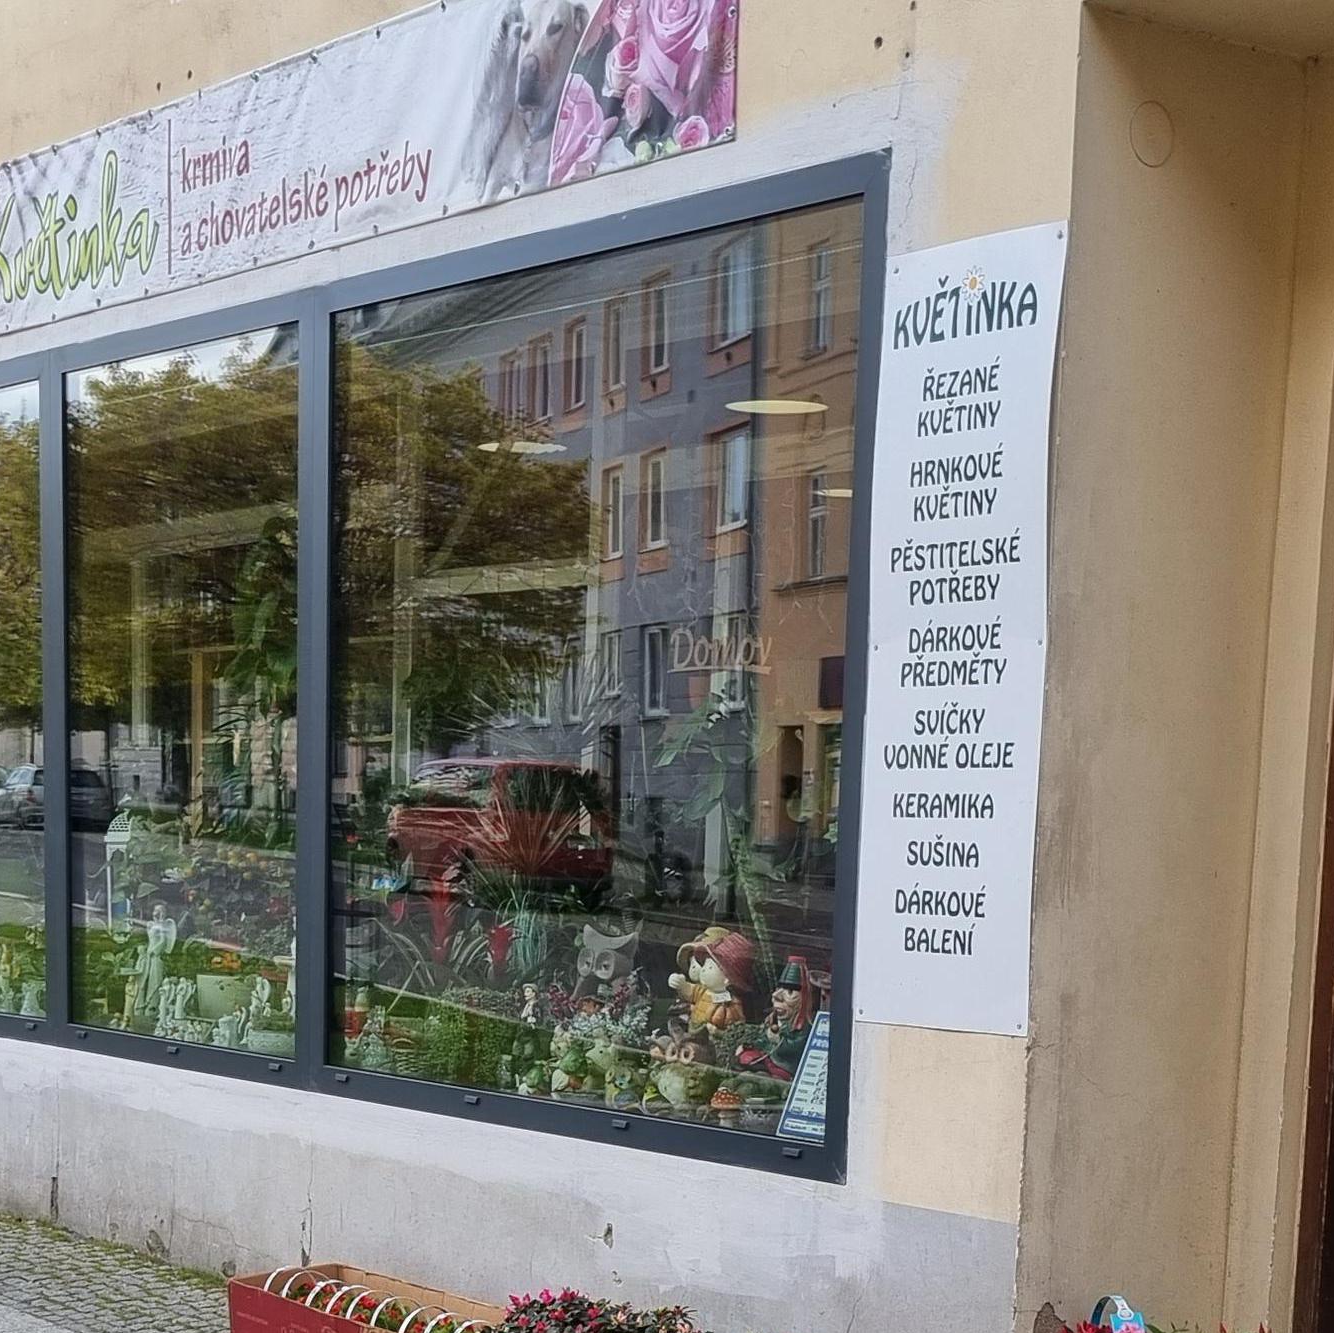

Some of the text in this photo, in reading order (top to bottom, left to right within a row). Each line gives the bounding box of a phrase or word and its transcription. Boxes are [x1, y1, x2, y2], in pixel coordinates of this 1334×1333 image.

[181, 136, 250, 193] krmiva
[181, 140, 433, 256] a chovatelské potřeby
[893, 275, 1038, 350] KVĚTINKA
[922, 355, 1001, 401] ŘEZANÉ
[917, 400, 1002, 437] KVĚTINY
[910, 442, 1004, 488] HRNKOVÉ
[913, 485, 998, 523] KVĚTINY
[890, 527, 1021, 573] PĚSTITELSKÉ
[909, 570, 1001, 606] POTŘEBY
[670, 627, 772, 672] Domov
[908, 616, 1002, 654] DÁRKOVÉ
[900, 652, 1008, 688] PŘEDMĚTY
[913, 702, 986, 736] SVÍČKY
[883, 735, 1016, 770] VONNÉ OLEJE
[892, 792, 994, 820] KERAMIKA
[906, 834, 980, 869] SUŠINA
[894, 884, 987, 919] DÁRKOVÉ
[904, 922, 976, 956] BALENÍ
